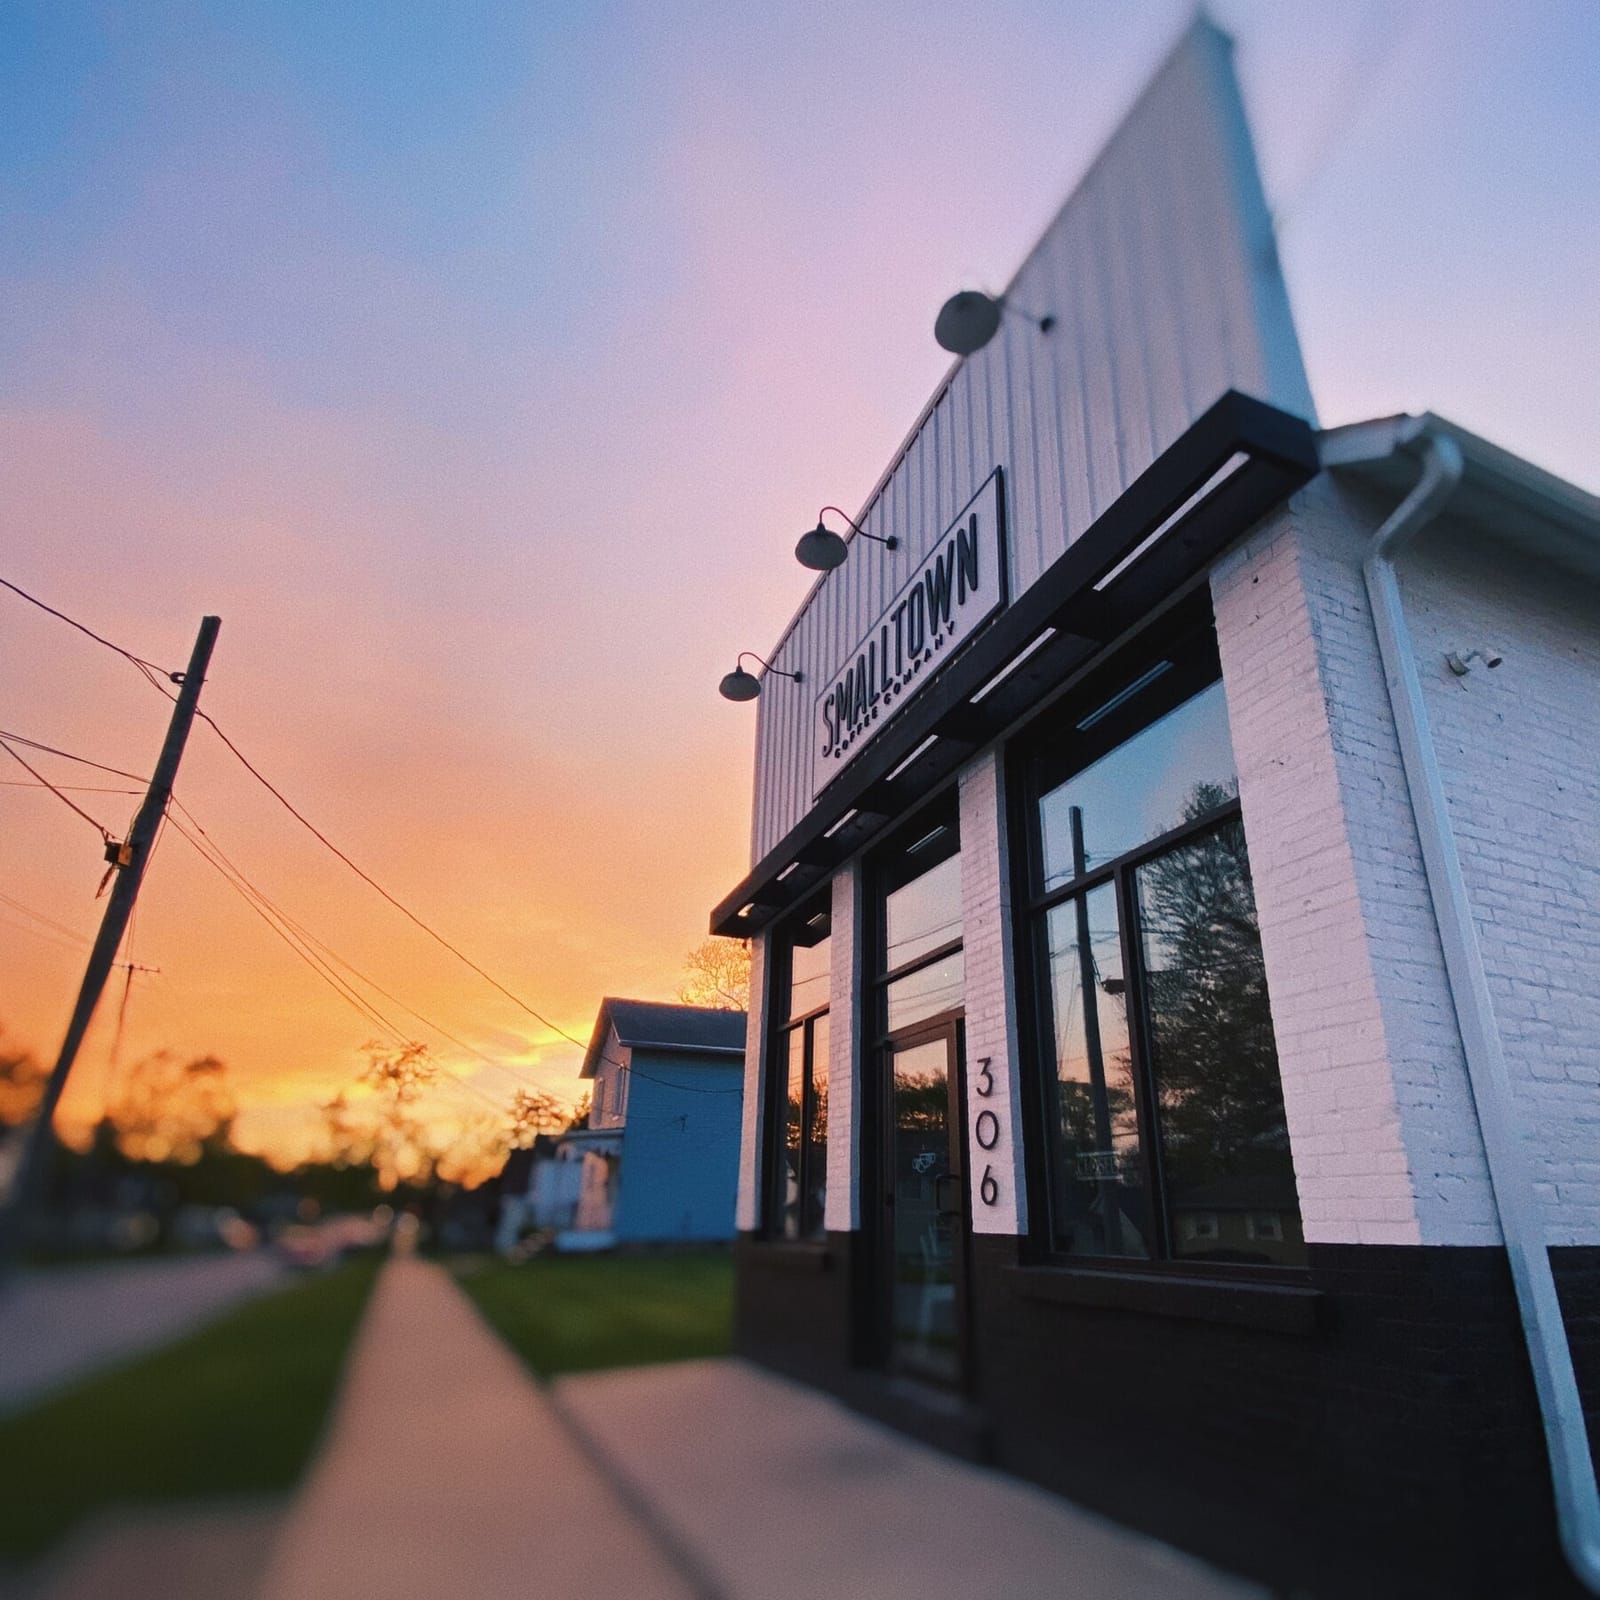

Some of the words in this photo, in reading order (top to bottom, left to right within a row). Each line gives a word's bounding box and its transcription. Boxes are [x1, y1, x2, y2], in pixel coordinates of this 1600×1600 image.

[822, 512, 978, 758] SMALLTOWN
[834, 706, 878, 759] COFFEE
[883, 620, 955, 705] COMPANY
[975, 1056, 1000, 1206] 306
